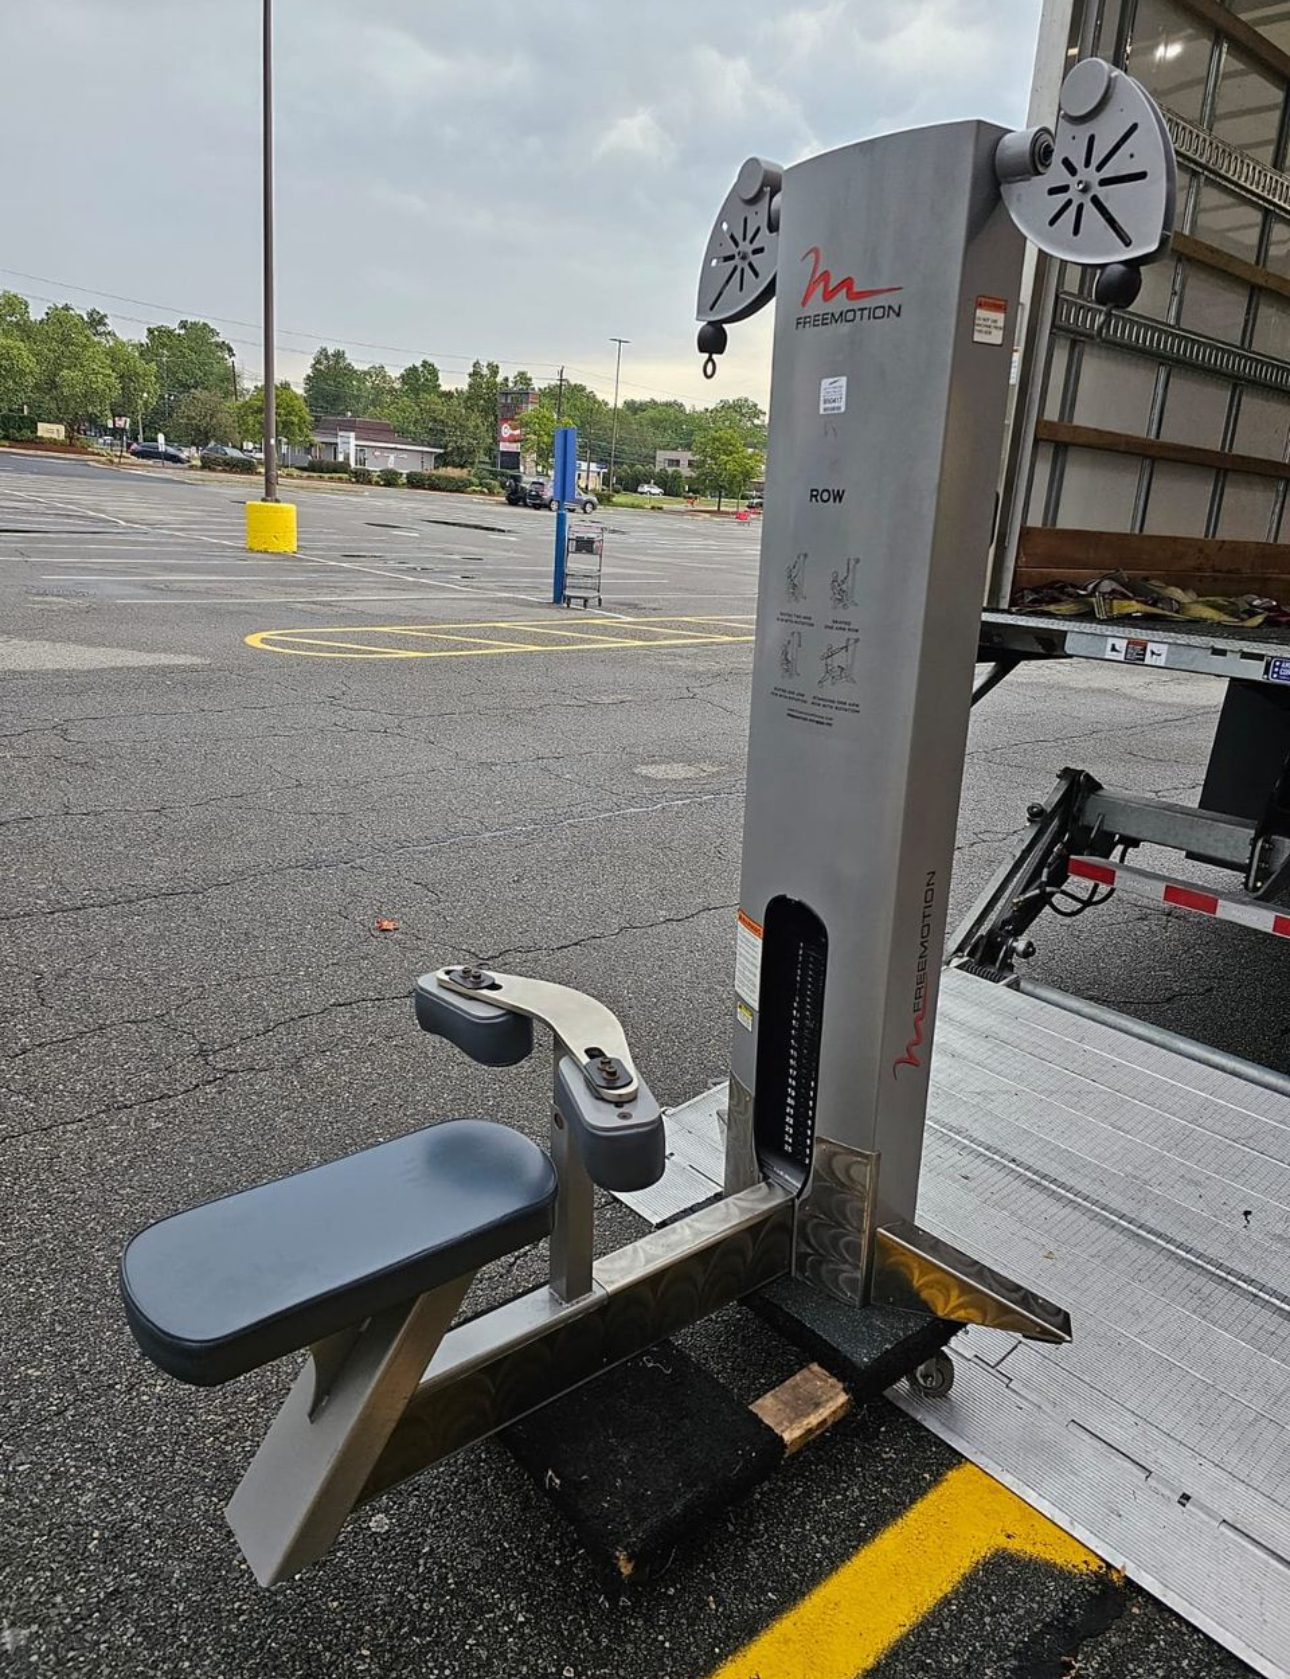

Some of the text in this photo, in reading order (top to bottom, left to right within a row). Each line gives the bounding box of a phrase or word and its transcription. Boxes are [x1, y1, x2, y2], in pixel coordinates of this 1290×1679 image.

[795, 304, 902, 330] FREEMOTION
[809, 488, 845, 504] ROW
[913, 871, 936, 1013] FREEMOTION
